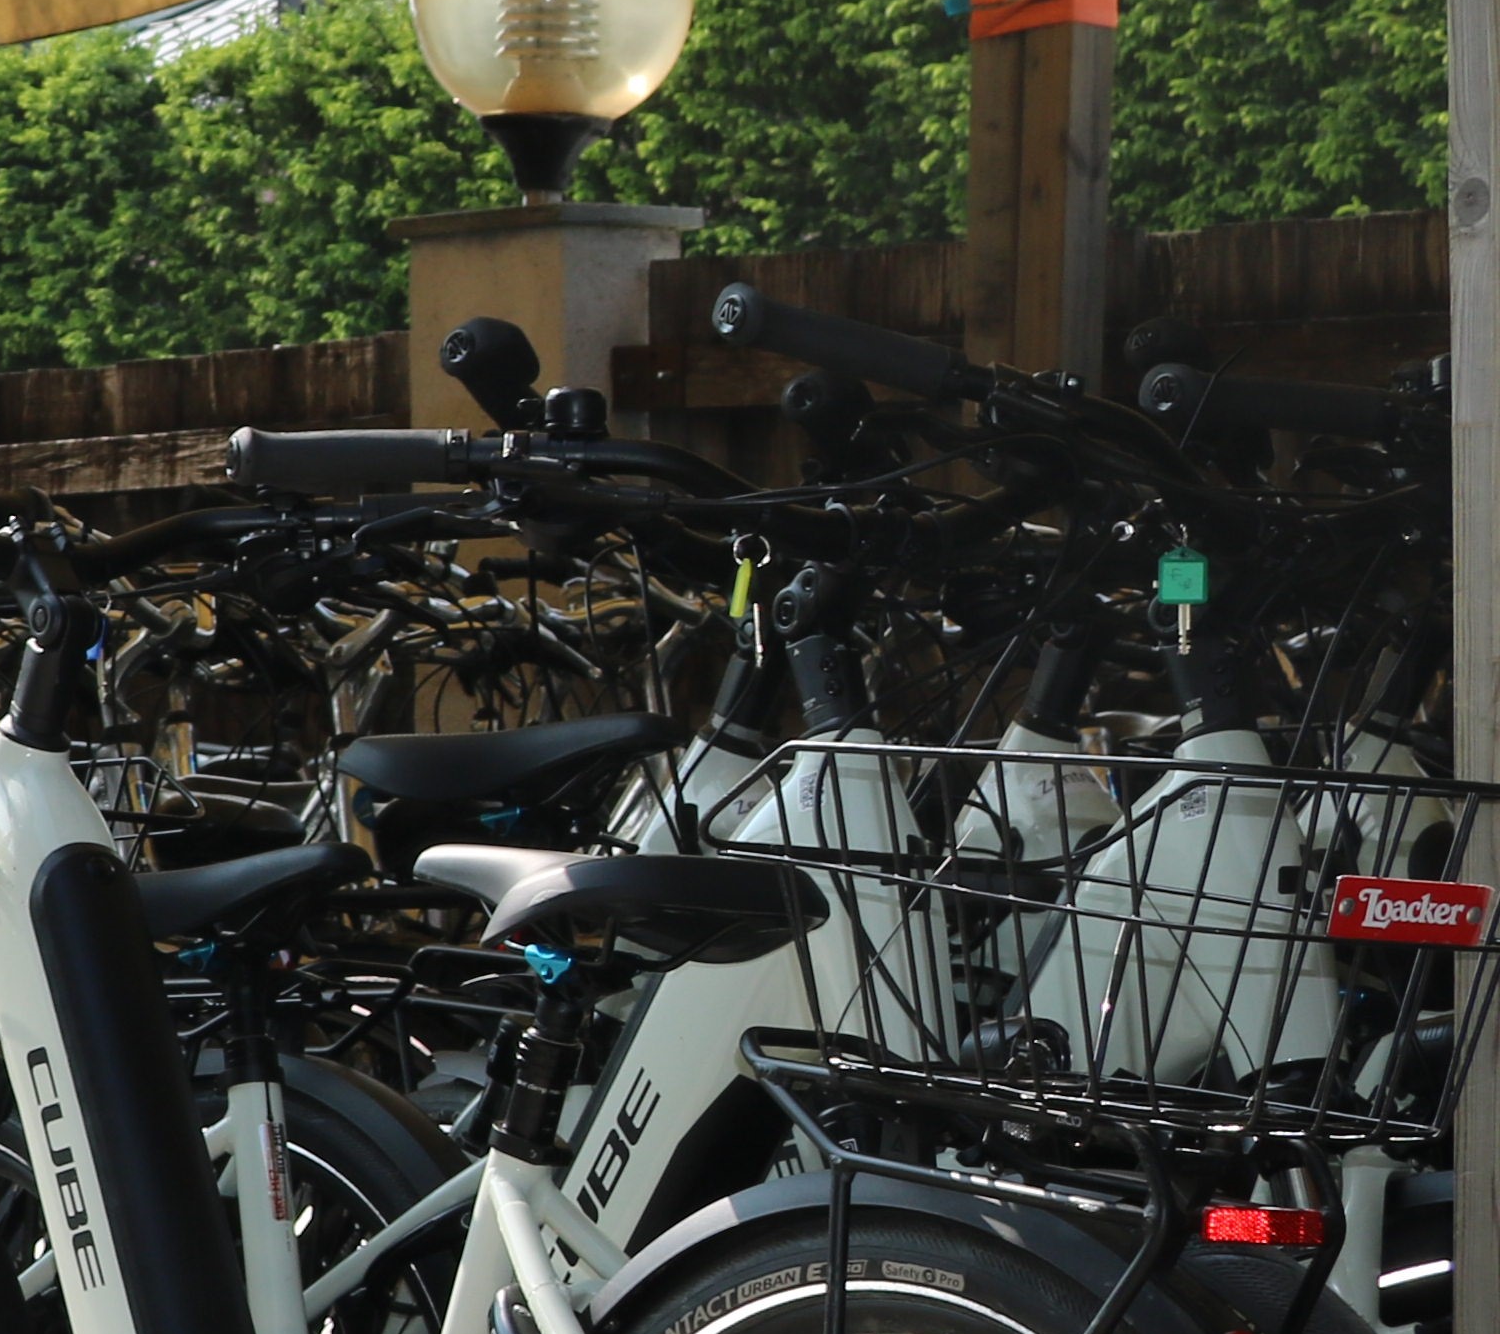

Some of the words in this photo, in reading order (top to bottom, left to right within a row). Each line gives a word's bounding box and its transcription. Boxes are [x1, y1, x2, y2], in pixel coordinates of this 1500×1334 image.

[1358, 888, 1465, 929] Loacker
[27, 1046, 106, 1292] CUBE
[740, 1269, 798, 1299] URBAN
[884, 1263, 920, 1281] Safety
[939, 1276, 960, 1289] Pro
